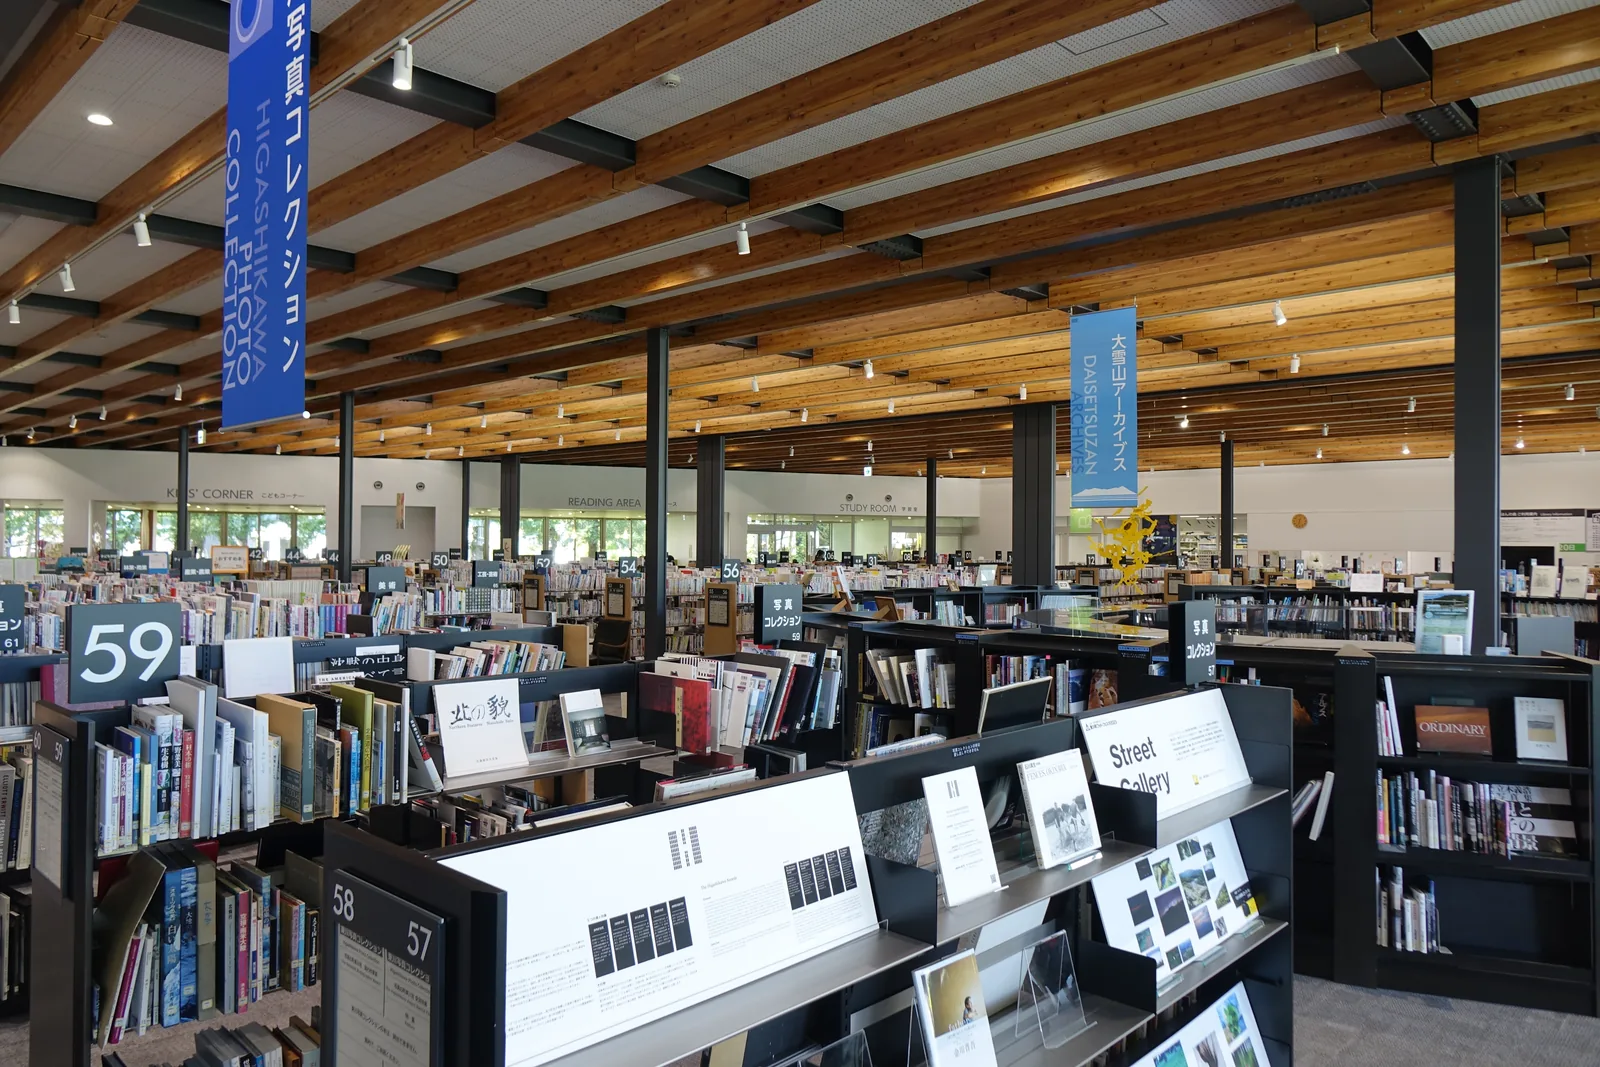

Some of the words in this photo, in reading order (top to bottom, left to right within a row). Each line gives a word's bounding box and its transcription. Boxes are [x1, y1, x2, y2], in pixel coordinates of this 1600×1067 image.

[283, 0, 305, 373] 写真コレクション
[252, 98, 271, 382] HIGASHIKAWA
[222, 128, 241, 390] COLLECTION
[236, 240, 253, 385] PHOTO
[1111, 333, 1127, 472] 大雪山アーカイブス
[1083, 354, 1098, 476] DAISETSUZAN
[1070, 391, 1084, 474] ARCHIVES
[166, 488, 198, 498] KIS'
[202, 489, 254, 499] CORNER
[568, 497, 613, 507] READING
[615, 498, 641, 507] AREA
[840, 503, 868, 512] STUDY
[870, 504, 897, 513] ROOM
[249, 549, 262, 559] 42
[286, 550, 300, 560] 44
[433, 554, 448, 567] 50
[868, 556, 877, 566] 31
[1087, 555, 1096, 565] 12
[621, 560, 637, 574] 54
[723, 563, 739, 578] 56
[1296, 562, 1304, 576] 29
[377, 581, 397, 590] 美術
[773, 598, 793, 611] 写真
[764, 615, 801, 628] コレクション
[1193, 619, 1209, 636] 写真
[4, 638, 19, 648] 61
[792, 632, 801, 641] 59
[80, 621, 173, 684] 59
[1186, 641, 1215, 659] コレクション
[1207, 664, 1215, 677] 57
[1419, 721, 1487, 735] ORDINARY
[33, 731, 42, 750] 60
[54, 742, 63, 763] 59
[1109, 736, 1157, 768] Street
[333, 883, 355, 922] 58
[407, 920, 432, 962] 57
